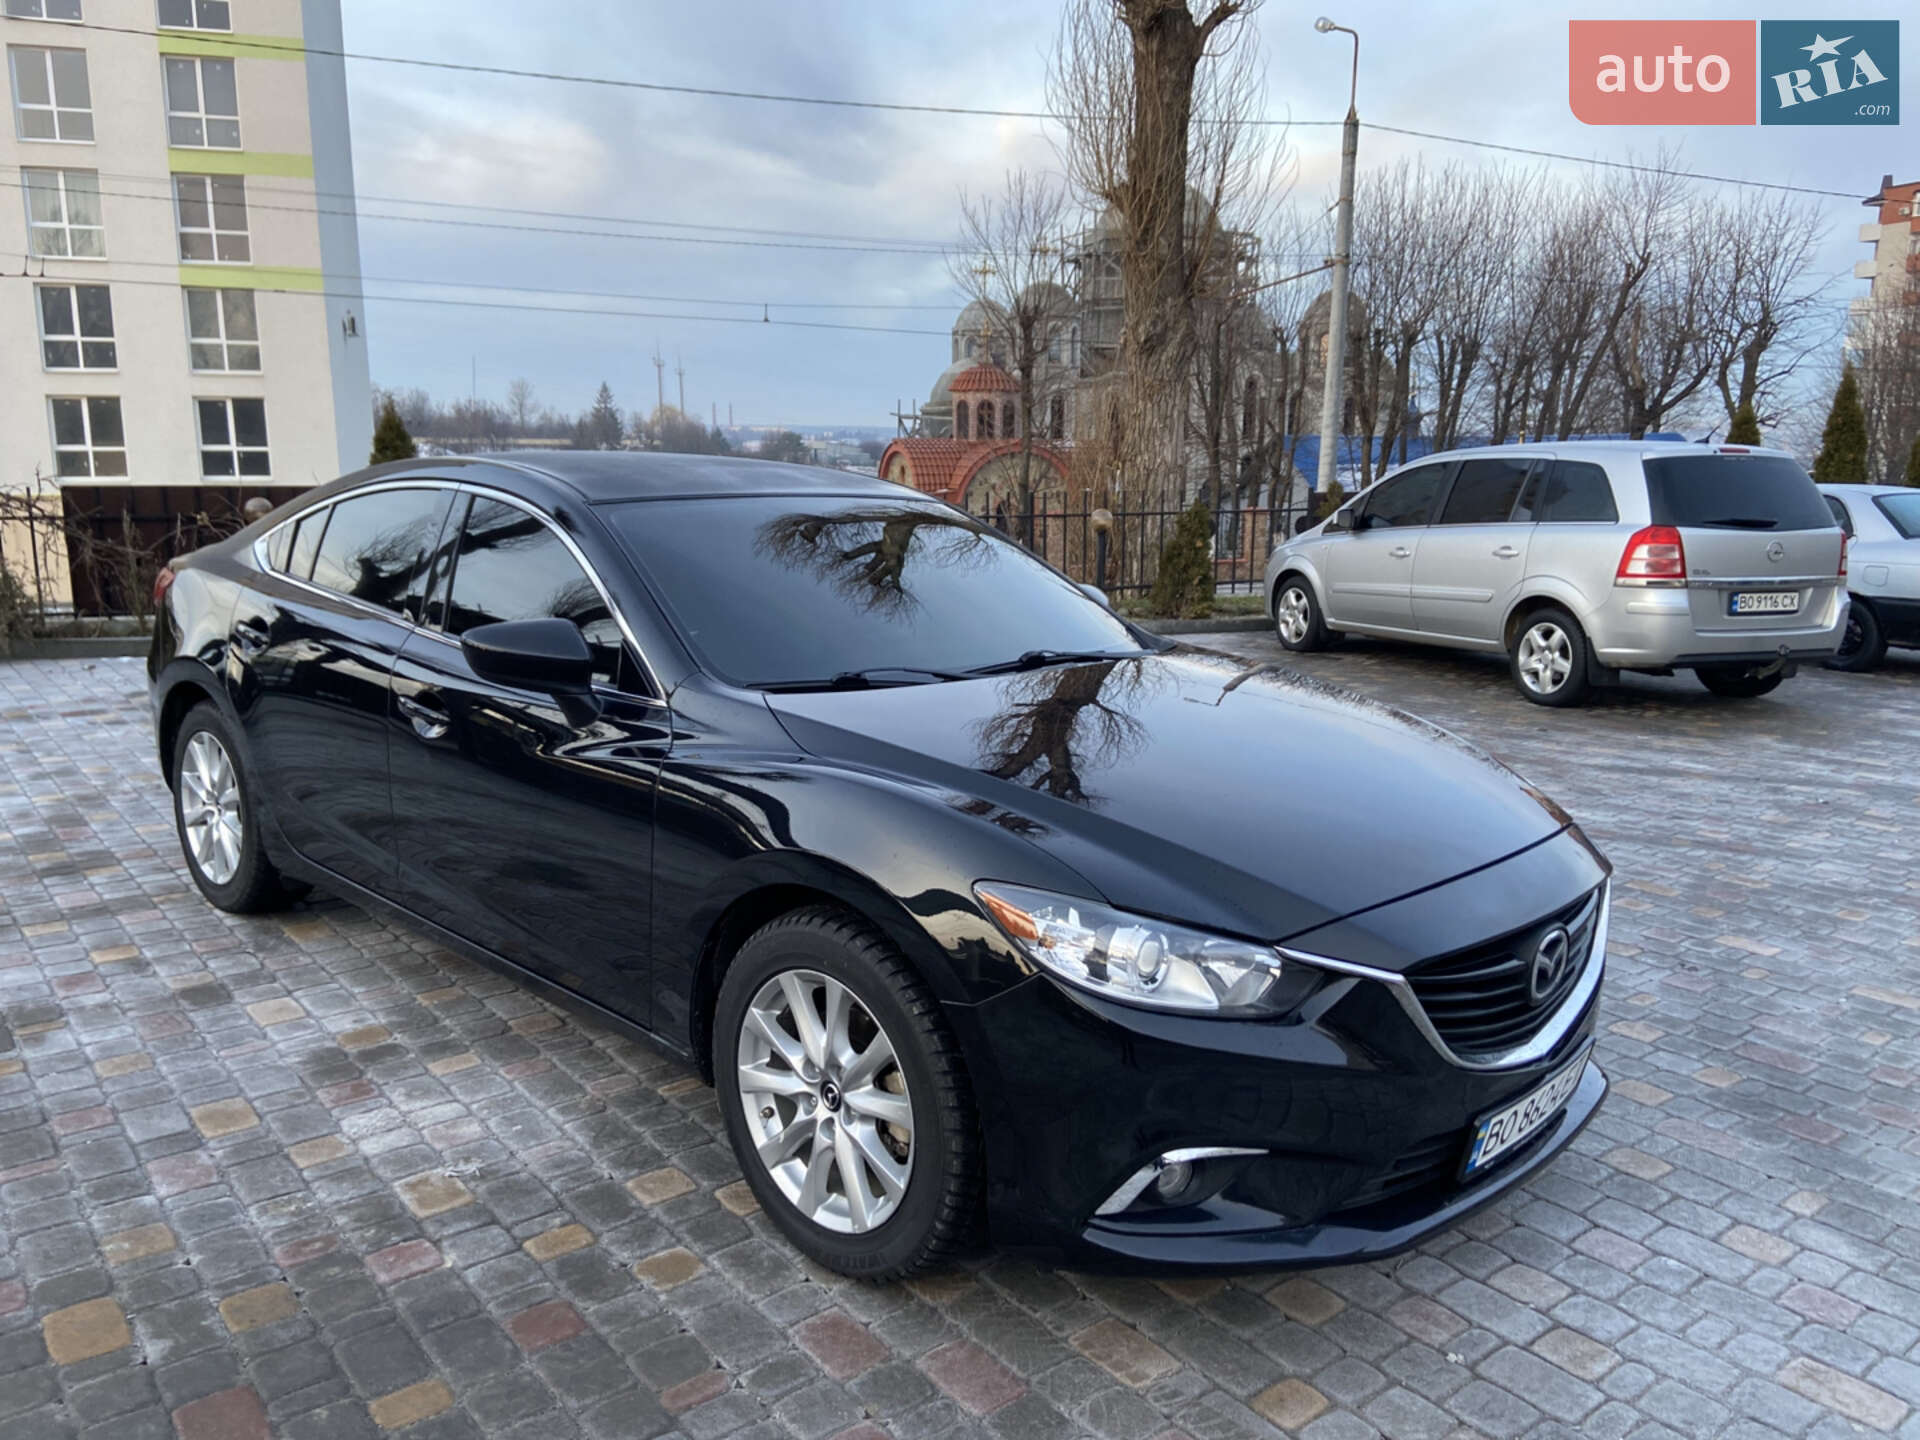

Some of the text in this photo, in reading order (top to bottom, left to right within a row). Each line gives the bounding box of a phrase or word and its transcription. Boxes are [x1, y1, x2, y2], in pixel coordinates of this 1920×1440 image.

[1740, 594, 1797, 609] BO 9116 CX
[1482, 1110, 1518, 1156] BO
